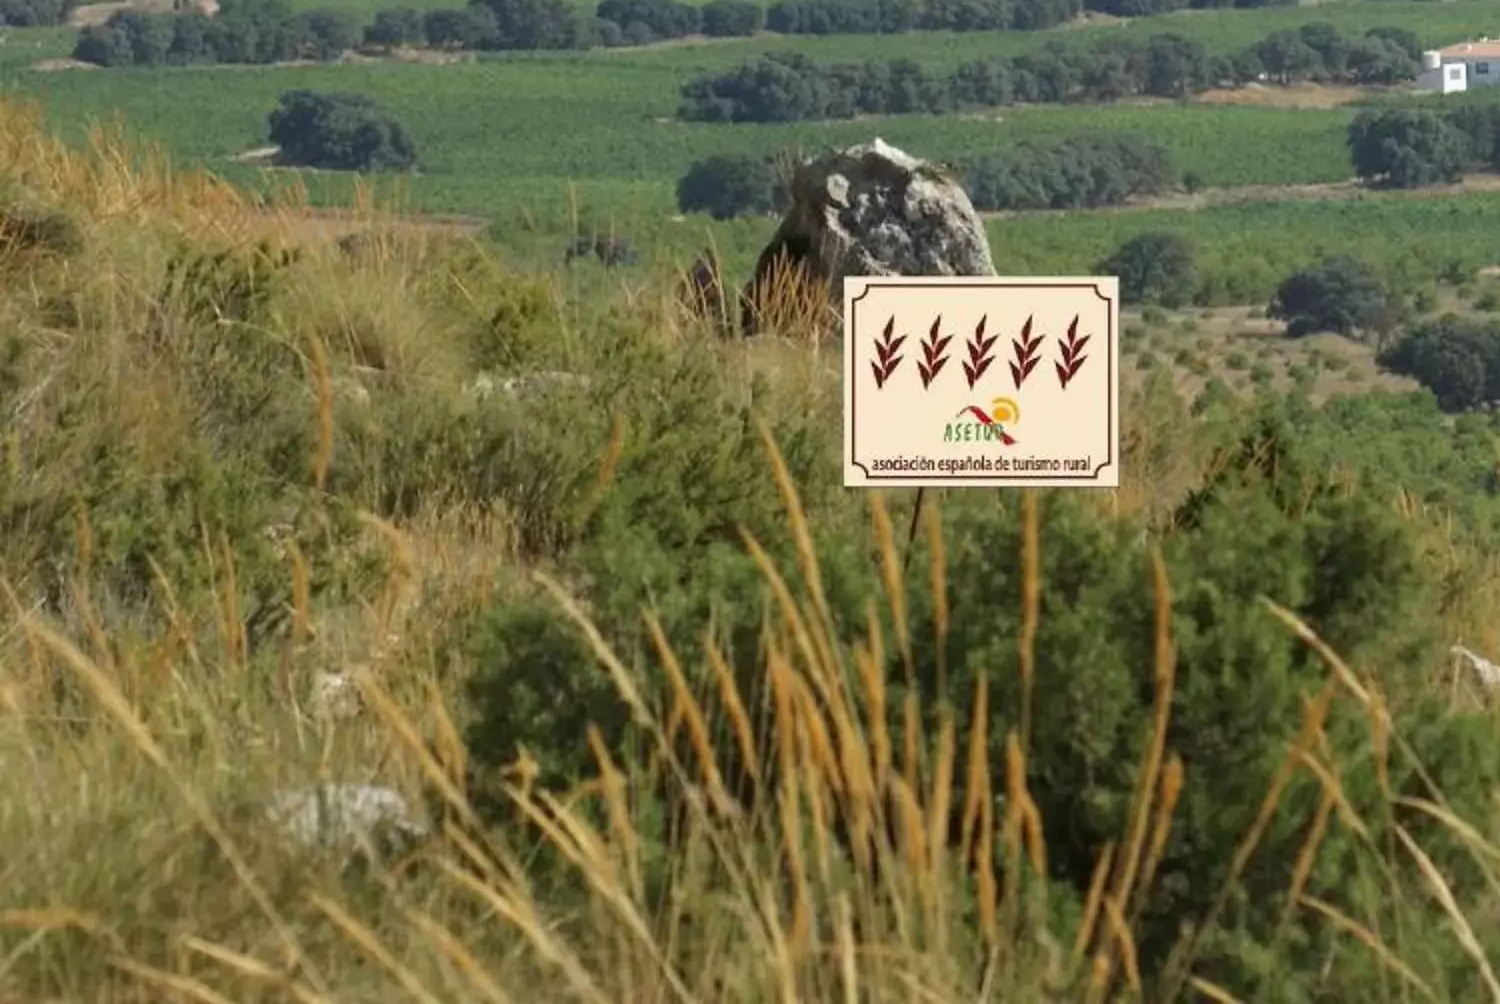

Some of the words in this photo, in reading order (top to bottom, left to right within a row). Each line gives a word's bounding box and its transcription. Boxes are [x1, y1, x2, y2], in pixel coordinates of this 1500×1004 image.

[872, 455, 935, 471] asociación
[938, 455, 992, 474] española
[994, 455, 1010, 471] de
[1012, 455, 1060, 471] turismo
[1063, 455, 1091, 471] rural
